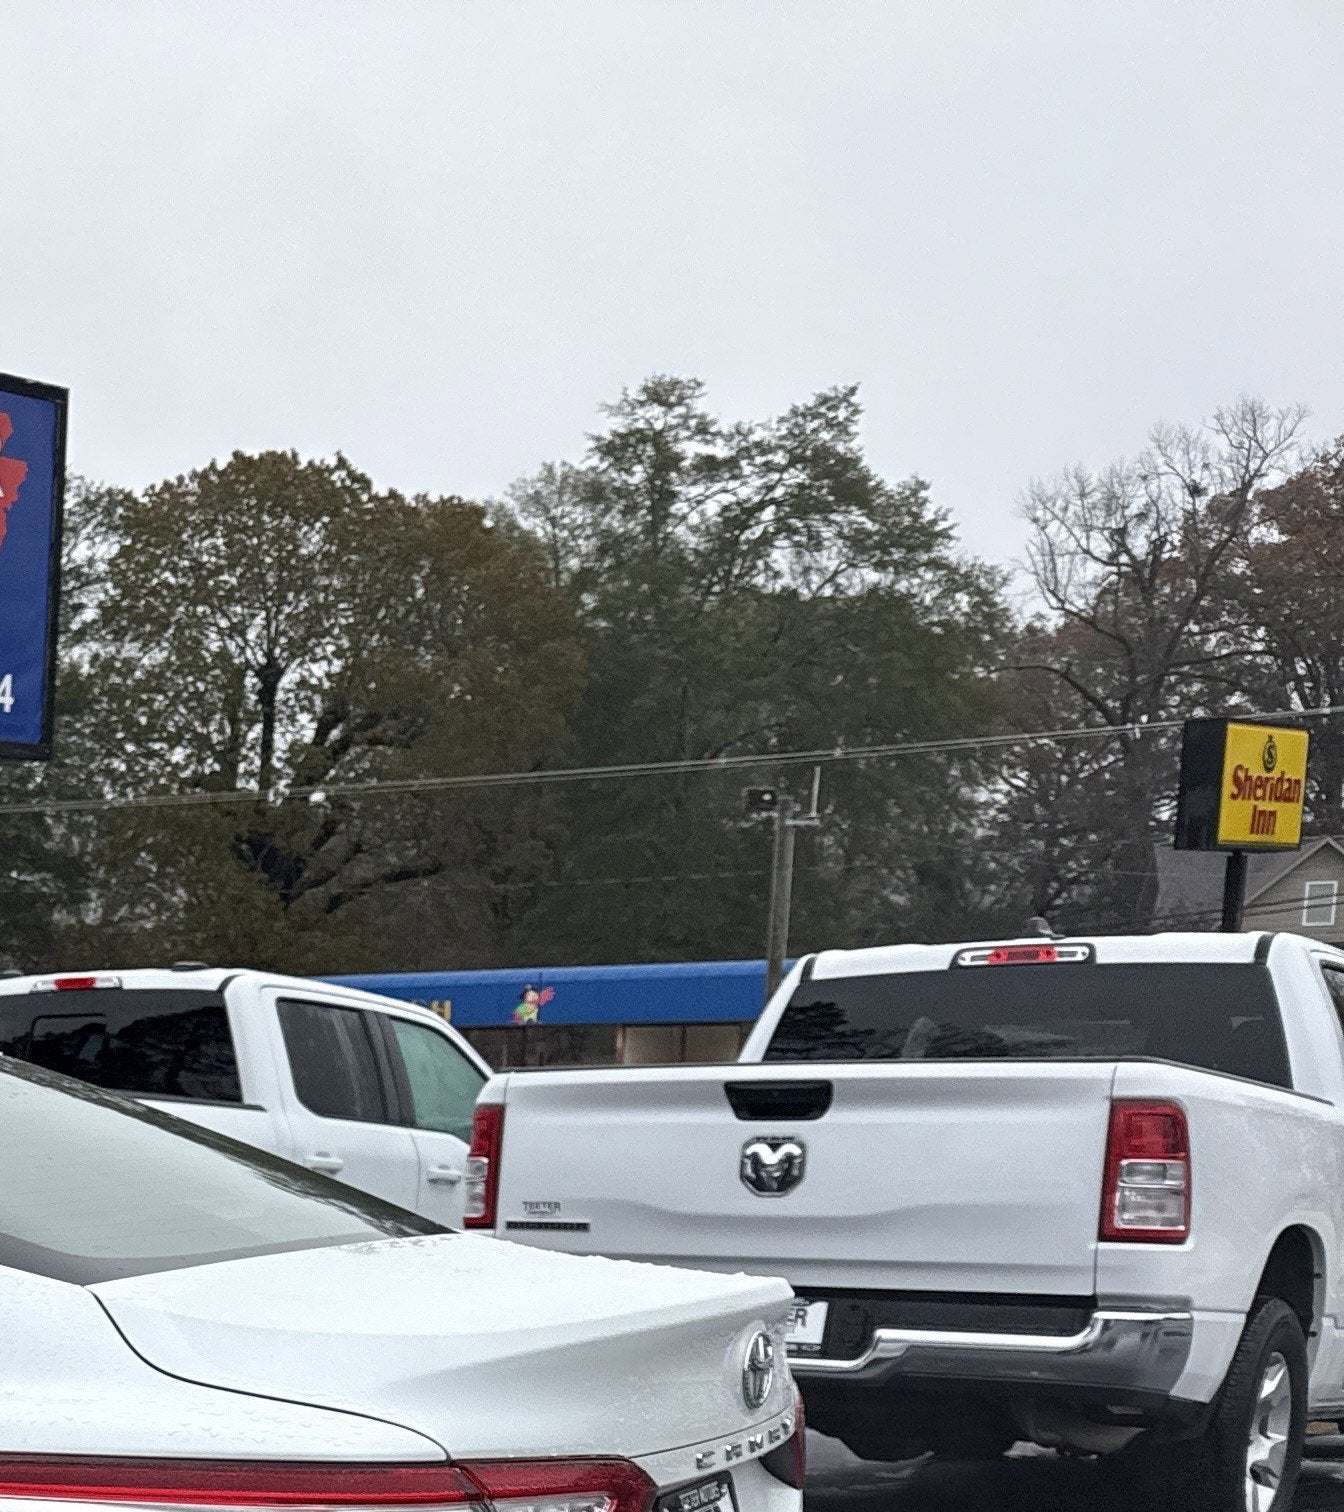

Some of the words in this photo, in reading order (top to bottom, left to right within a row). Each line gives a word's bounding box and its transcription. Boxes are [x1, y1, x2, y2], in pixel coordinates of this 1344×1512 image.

[1230, 764, 1303, 804] Sheridan
[1249, 804, 1278, 836] Inn
[523, 1201, 561, 1213] TEETER
